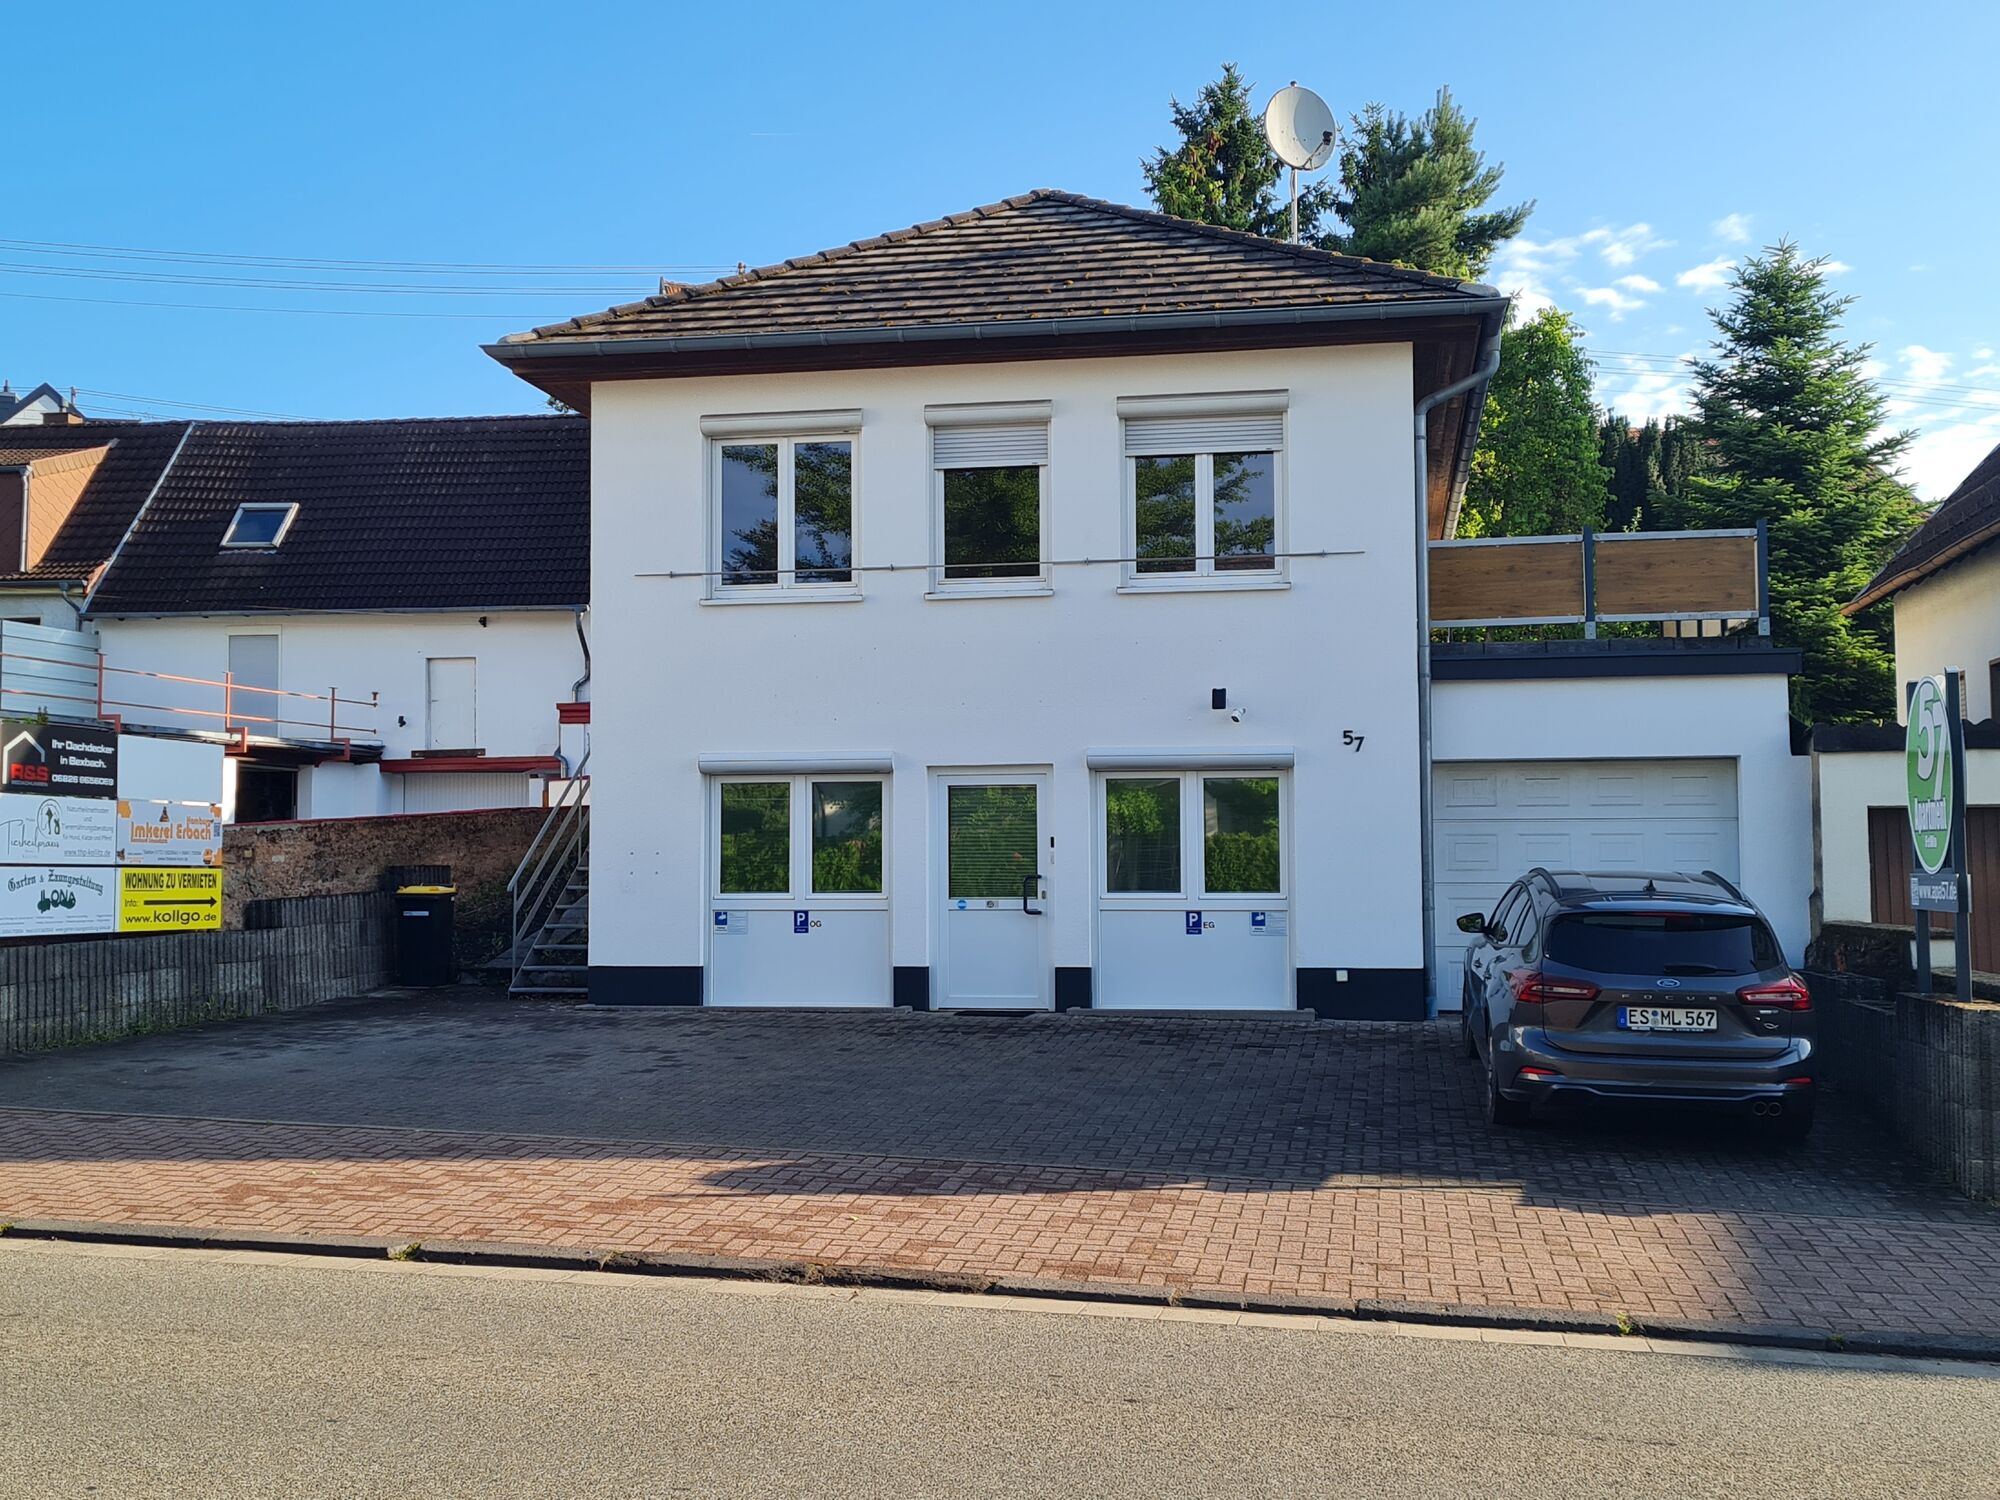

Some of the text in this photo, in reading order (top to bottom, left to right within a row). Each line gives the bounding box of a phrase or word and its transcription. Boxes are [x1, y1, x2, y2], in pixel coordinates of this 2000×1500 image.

[52, 739, 115, 754] Ihr Dachdecker
[1342, 730, 1365, 752] 57
[1917, 681, 1946, 801] 57
[60, 755, 68, 765] in
[10, 763, 49, 782] R&S
[1914, 797, 1948, 834] Apartment
[130, 821, 173, 841] Imkerei
[175, 823, 212, 841] Erbach
[8, 875, 37, 892] Garten
[124, 873, 218, 889] WOHNUNG ZU VERMIETEN
[124, 899, 139, 908] Info:
[125, 910, 217, 925] www.kollgo.de
[797, 912, 806, 926] P
[809, 920, 822, 928] OG
[1189, 913, 1199, 927] P
[1203, 921, 1216, 929] EG
[1628, 1009, 1716, 1027] ES ML 567
